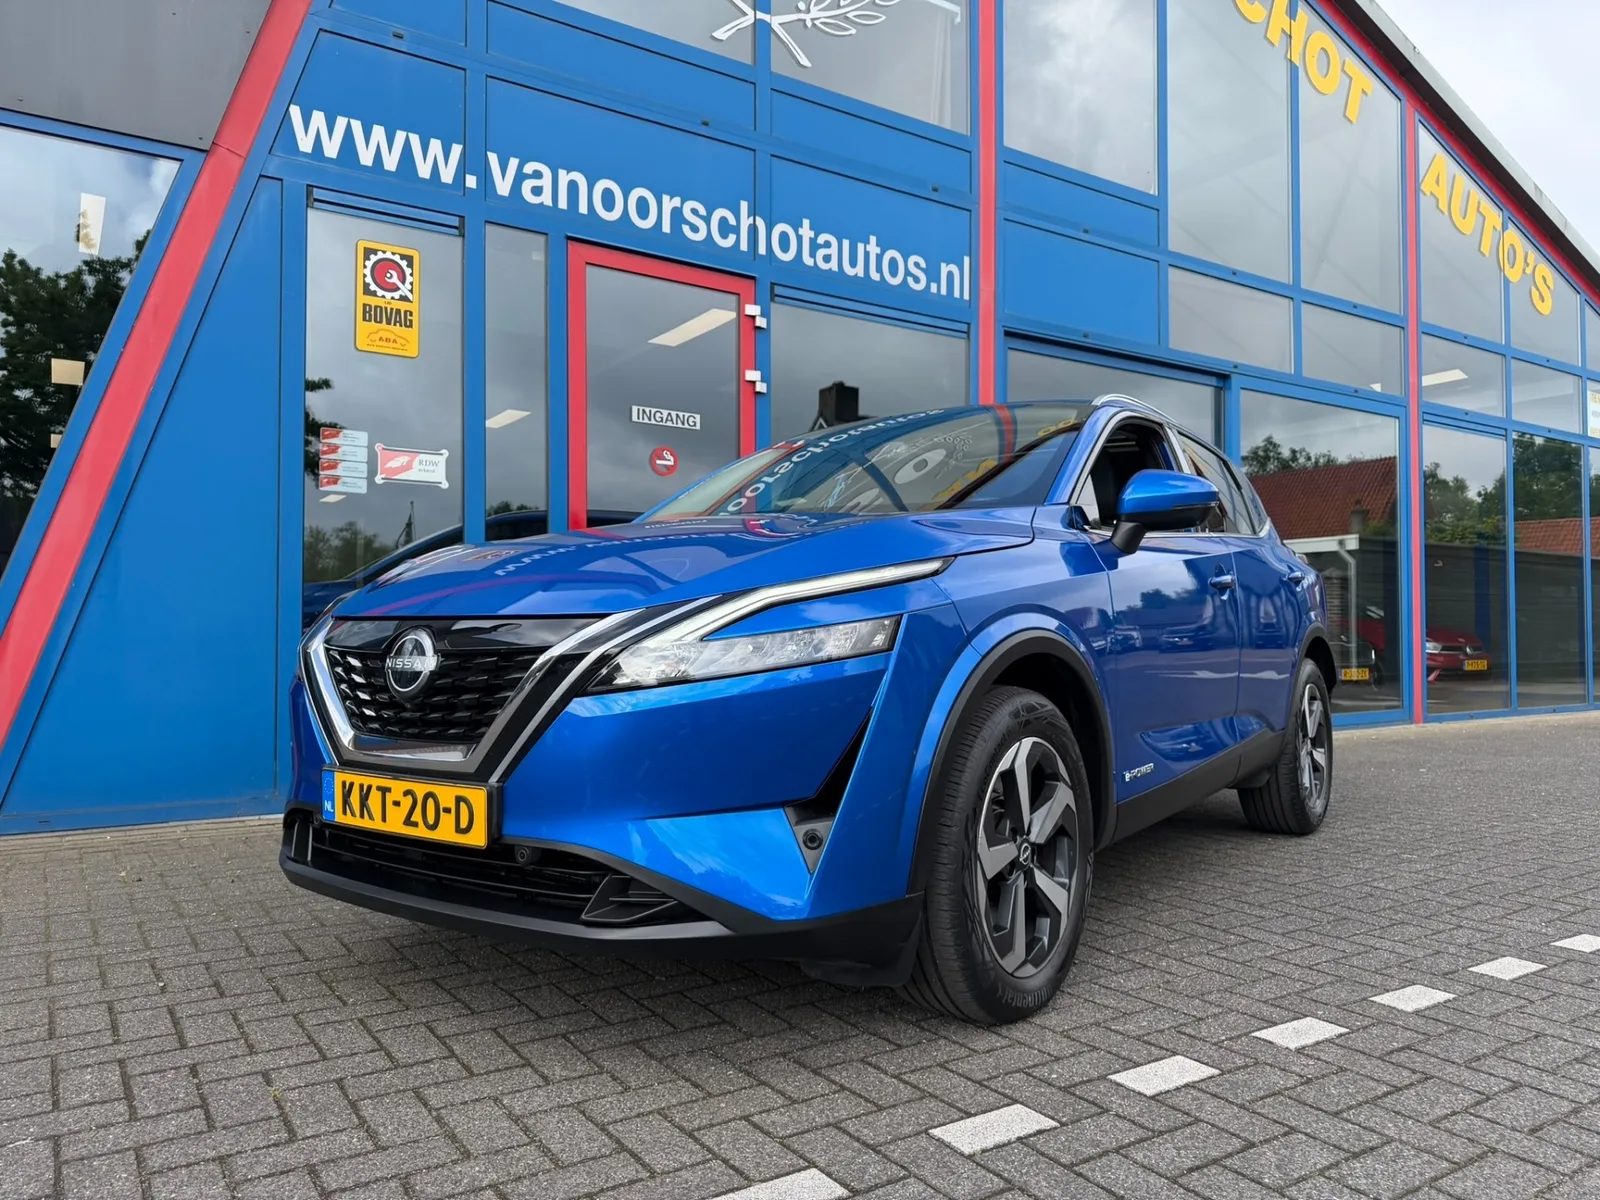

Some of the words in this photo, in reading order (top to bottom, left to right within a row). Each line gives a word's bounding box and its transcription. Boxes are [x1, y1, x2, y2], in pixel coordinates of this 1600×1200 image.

[288, 103, 970, 301] www.vanoorschotautos.nl
[1420, 152, 1554, 316] AUTO'S
[362, 302, 413, 329] BOVAG
[636, 407, 697, 428] INGANG
[418, 459, 440, 467] RDW
[385, 657, 434, 671] NISSAN
[324, 799, 334, 812] NL
[341, 780, 475, 835] KKT-20-D
